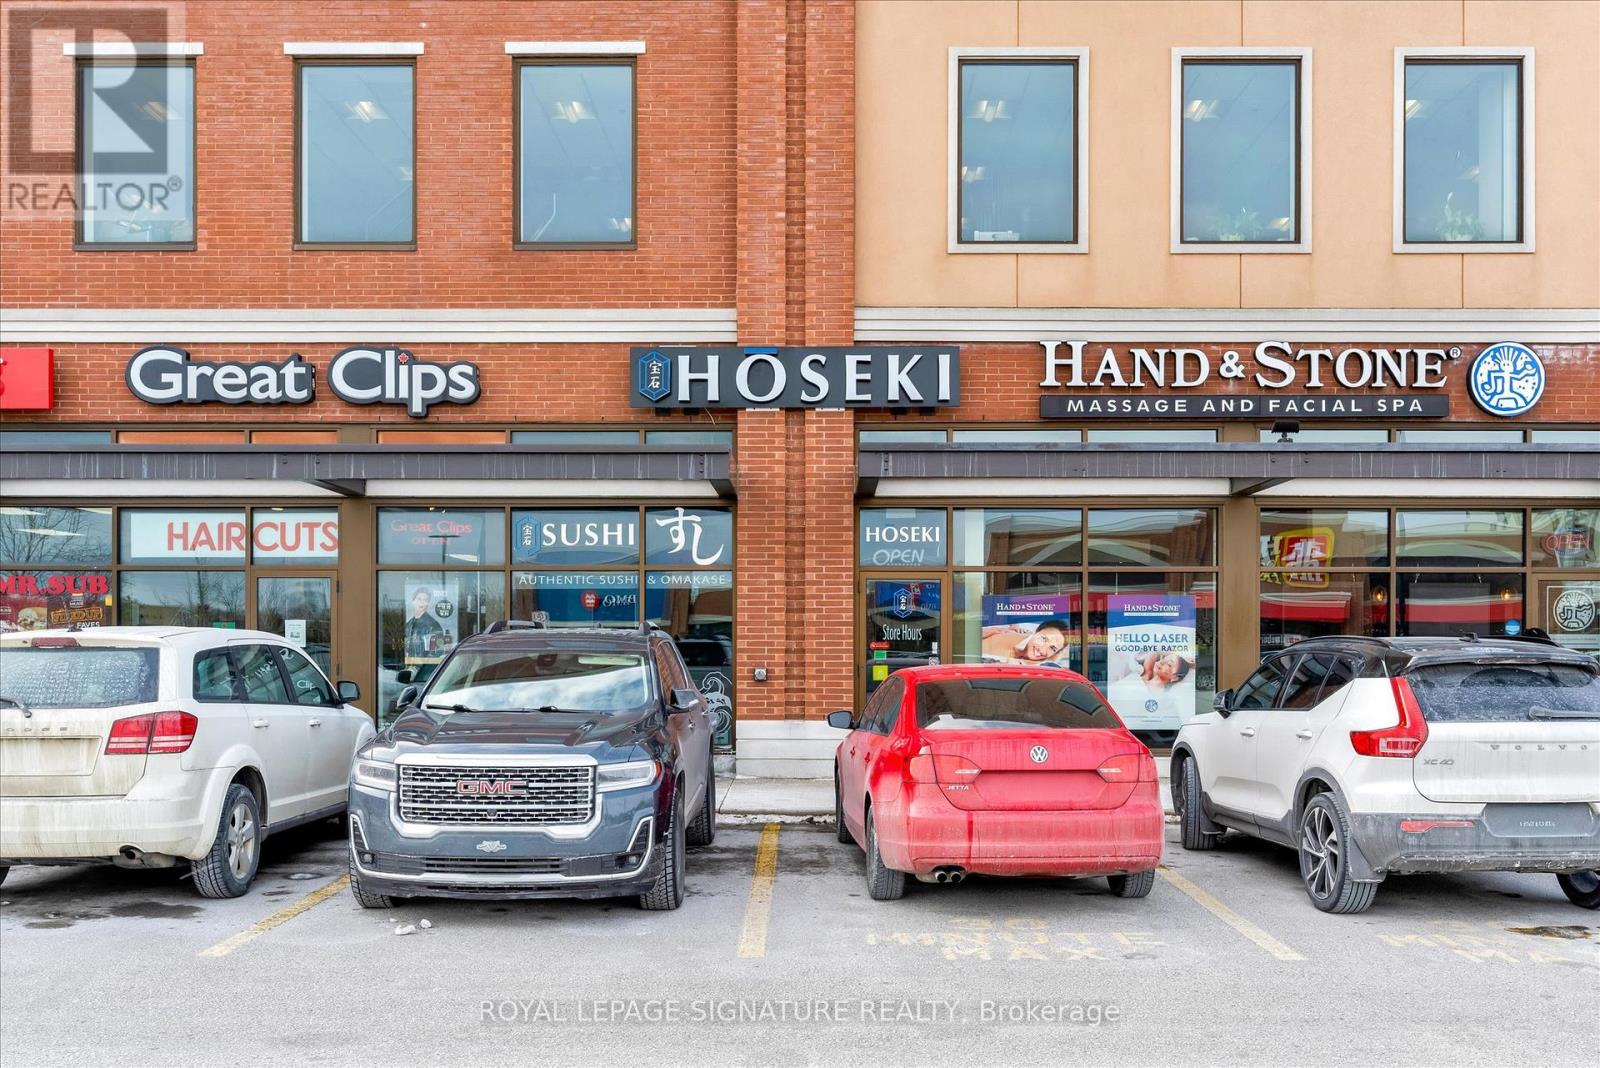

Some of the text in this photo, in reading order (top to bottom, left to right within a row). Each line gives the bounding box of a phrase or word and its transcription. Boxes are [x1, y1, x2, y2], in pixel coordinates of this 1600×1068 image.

[1039, 340, 1210, 389] HAND
[1219, 350, 1246, 379] &
[130, 349, 474, 414] Great Clips
[1066, 399, 1424, 413] MASSAGE AND FACIAL SPA
[542, 522, 635, 547] SUSHI
[1546, 533, 1590, 552] OPEN
[872, 548, 925, 566] OPEN
[46, 575, 109, 594] SUB
[518, 574, 726, 585] AUTHENTIC SUSHI & OMAKASE
[996, 602, 1021, 611] HAND
[1124, 603, 1148, 612] HAND
[882, 623, 923, 641] Store Hours
[1114, 633, 1189, 643] HELLO LASER
[456, 779, 528, 795] GMC
